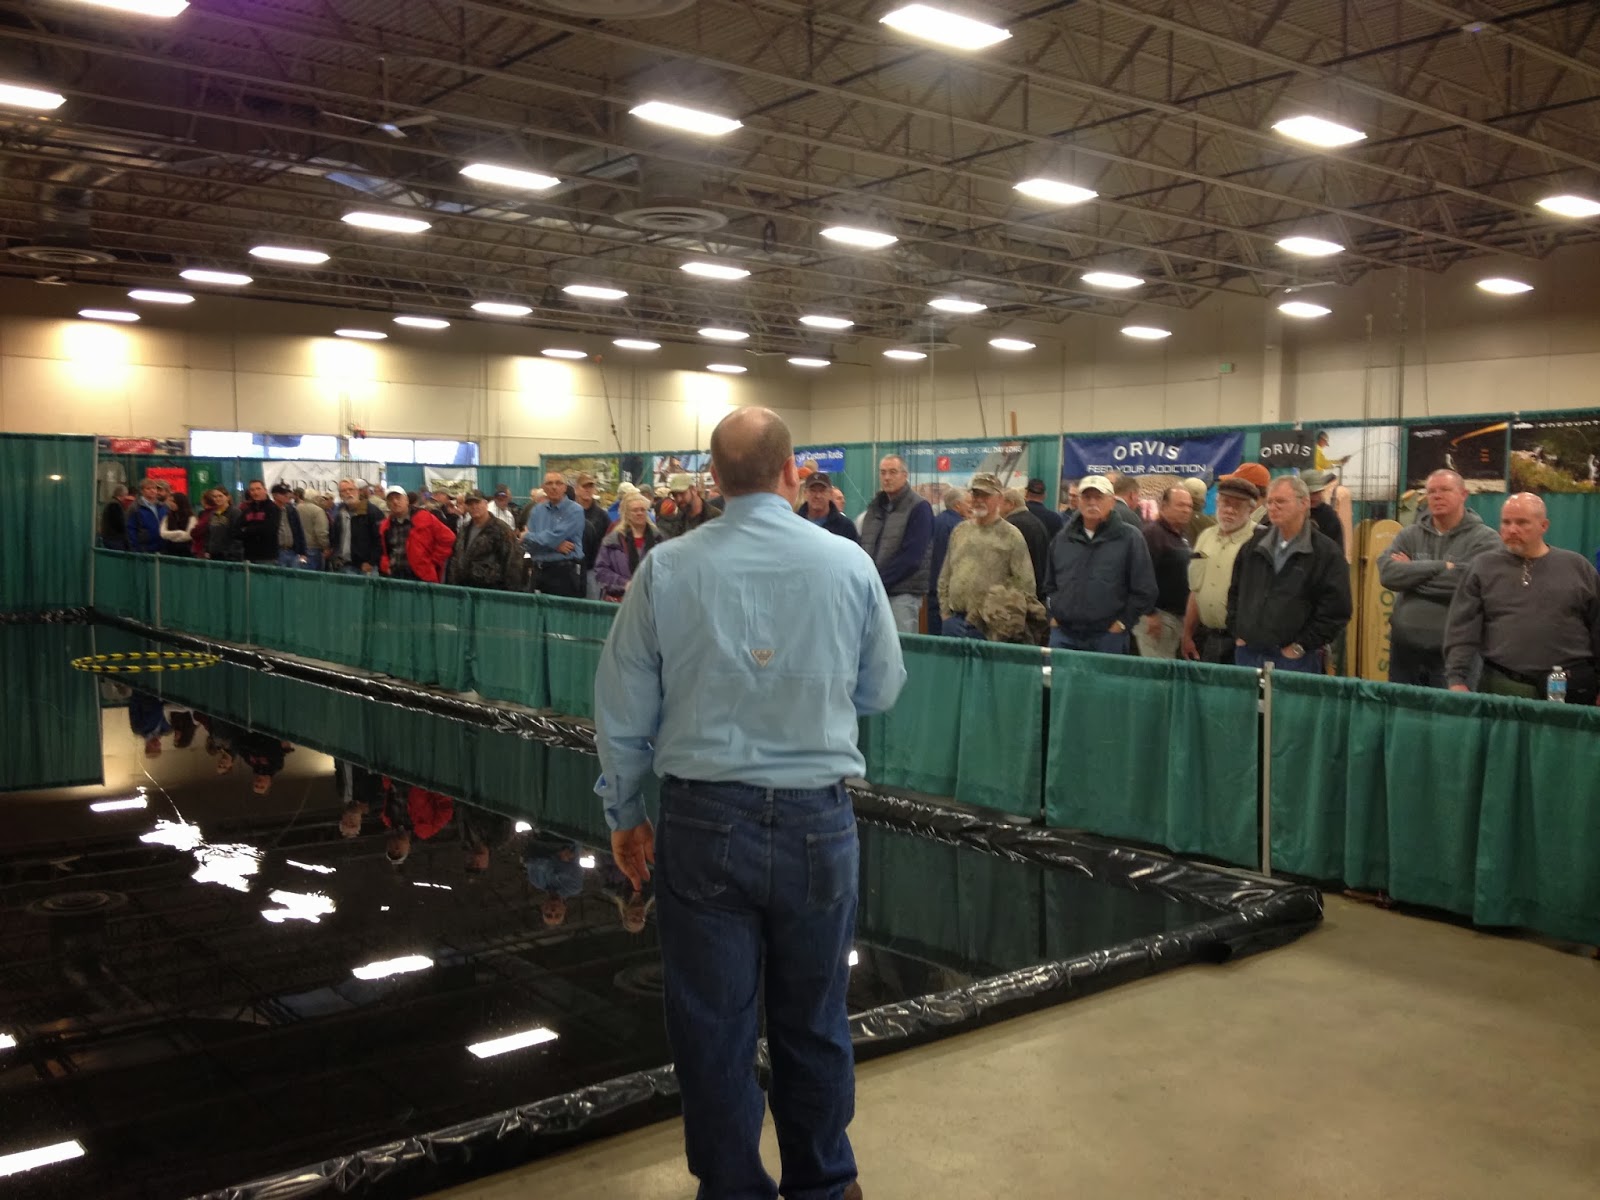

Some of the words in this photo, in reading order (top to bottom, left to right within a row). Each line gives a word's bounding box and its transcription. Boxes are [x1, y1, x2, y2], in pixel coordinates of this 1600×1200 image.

[1113, 441, 1180, 460] ORVIS
[1260, 442, 1312, 458] ORVIS
[1087, 464, 1114, 473] FEED
[1115, 464, 1145, 473] YOUR
[1148, 464, 1207, 473] ADDICTION
